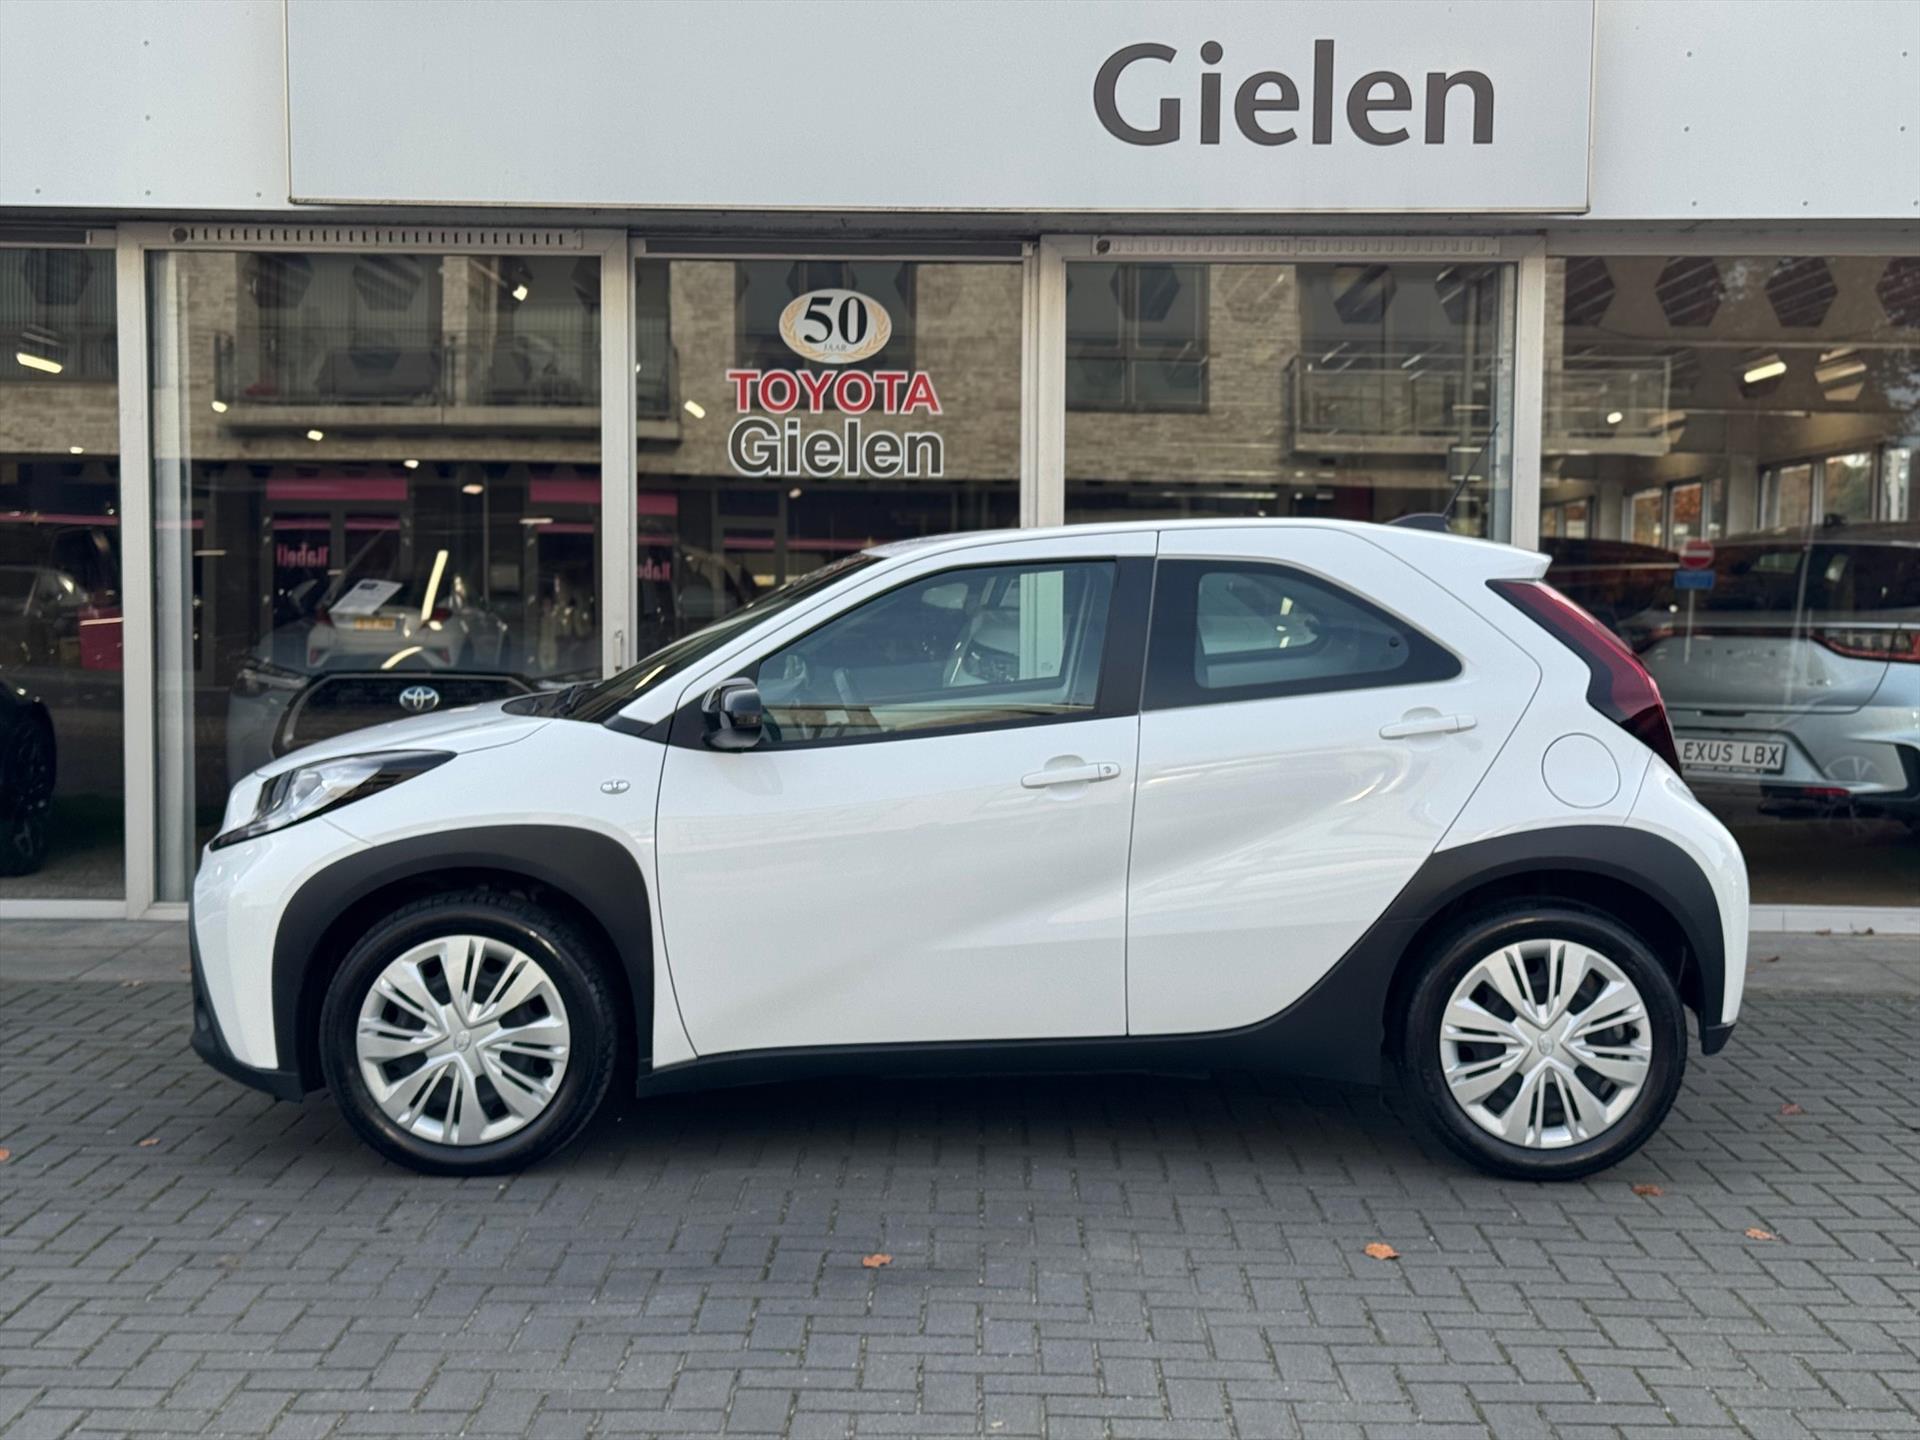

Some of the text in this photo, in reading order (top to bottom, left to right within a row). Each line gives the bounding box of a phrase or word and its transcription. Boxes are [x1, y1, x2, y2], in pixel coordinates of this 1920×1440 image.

[1093, 39, 1495, 146] Gielen
[803, 295, 868, 345] 50
[823, 343, 848, 353] JAAR
[726, 369, 943, 415] TOYOTA
[728, 416, 945, 478] Gielen
[1680, 741, 1780, 766] EXUS LBX
